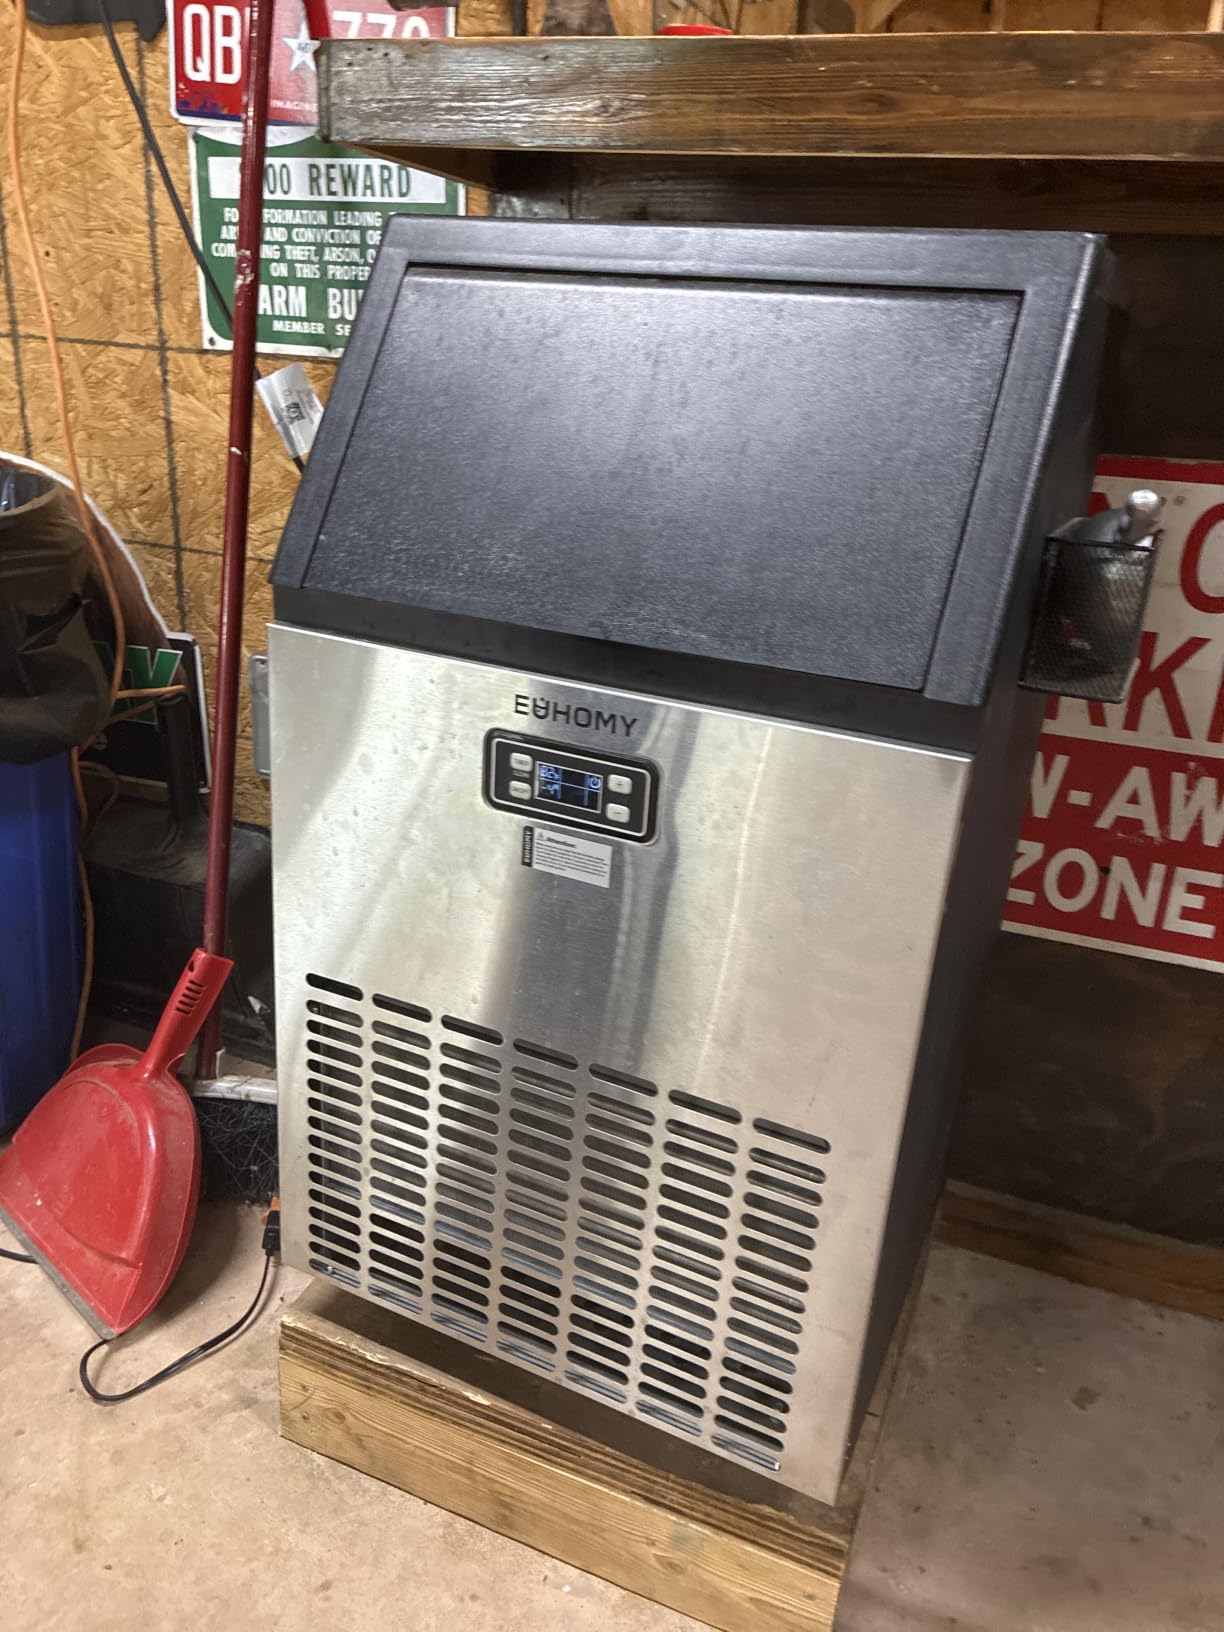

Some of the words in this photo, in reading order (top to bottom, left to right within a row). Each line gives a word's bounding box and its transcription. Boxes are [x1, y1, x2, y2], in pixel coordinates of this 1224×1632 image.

[183, 4, 250, 84] QB
[308, 163, 411, 198] REWARD
[223, 207, 240, 222] FO
[262, 208, 327, 225] FORMATION
[333, 211, 383, 226] LEADING
[264, 227, 288, 242] AND
[292, 228, 360, 244] CONVICTION
[365, 230, 382, 245] OF
[284, 245, 319, 262] THEFT,
[323, 247, 364, 264] ARSON,
[269, 262, 288, 278] ON
[294, 263, 321, 278] THIS
[327, 264, 371, 280] PROPER
[257, 284, 307, 317] ARM
[272, 320, 325, 335] MEMBER
[514, 694, 638, 737] EUHOMY
